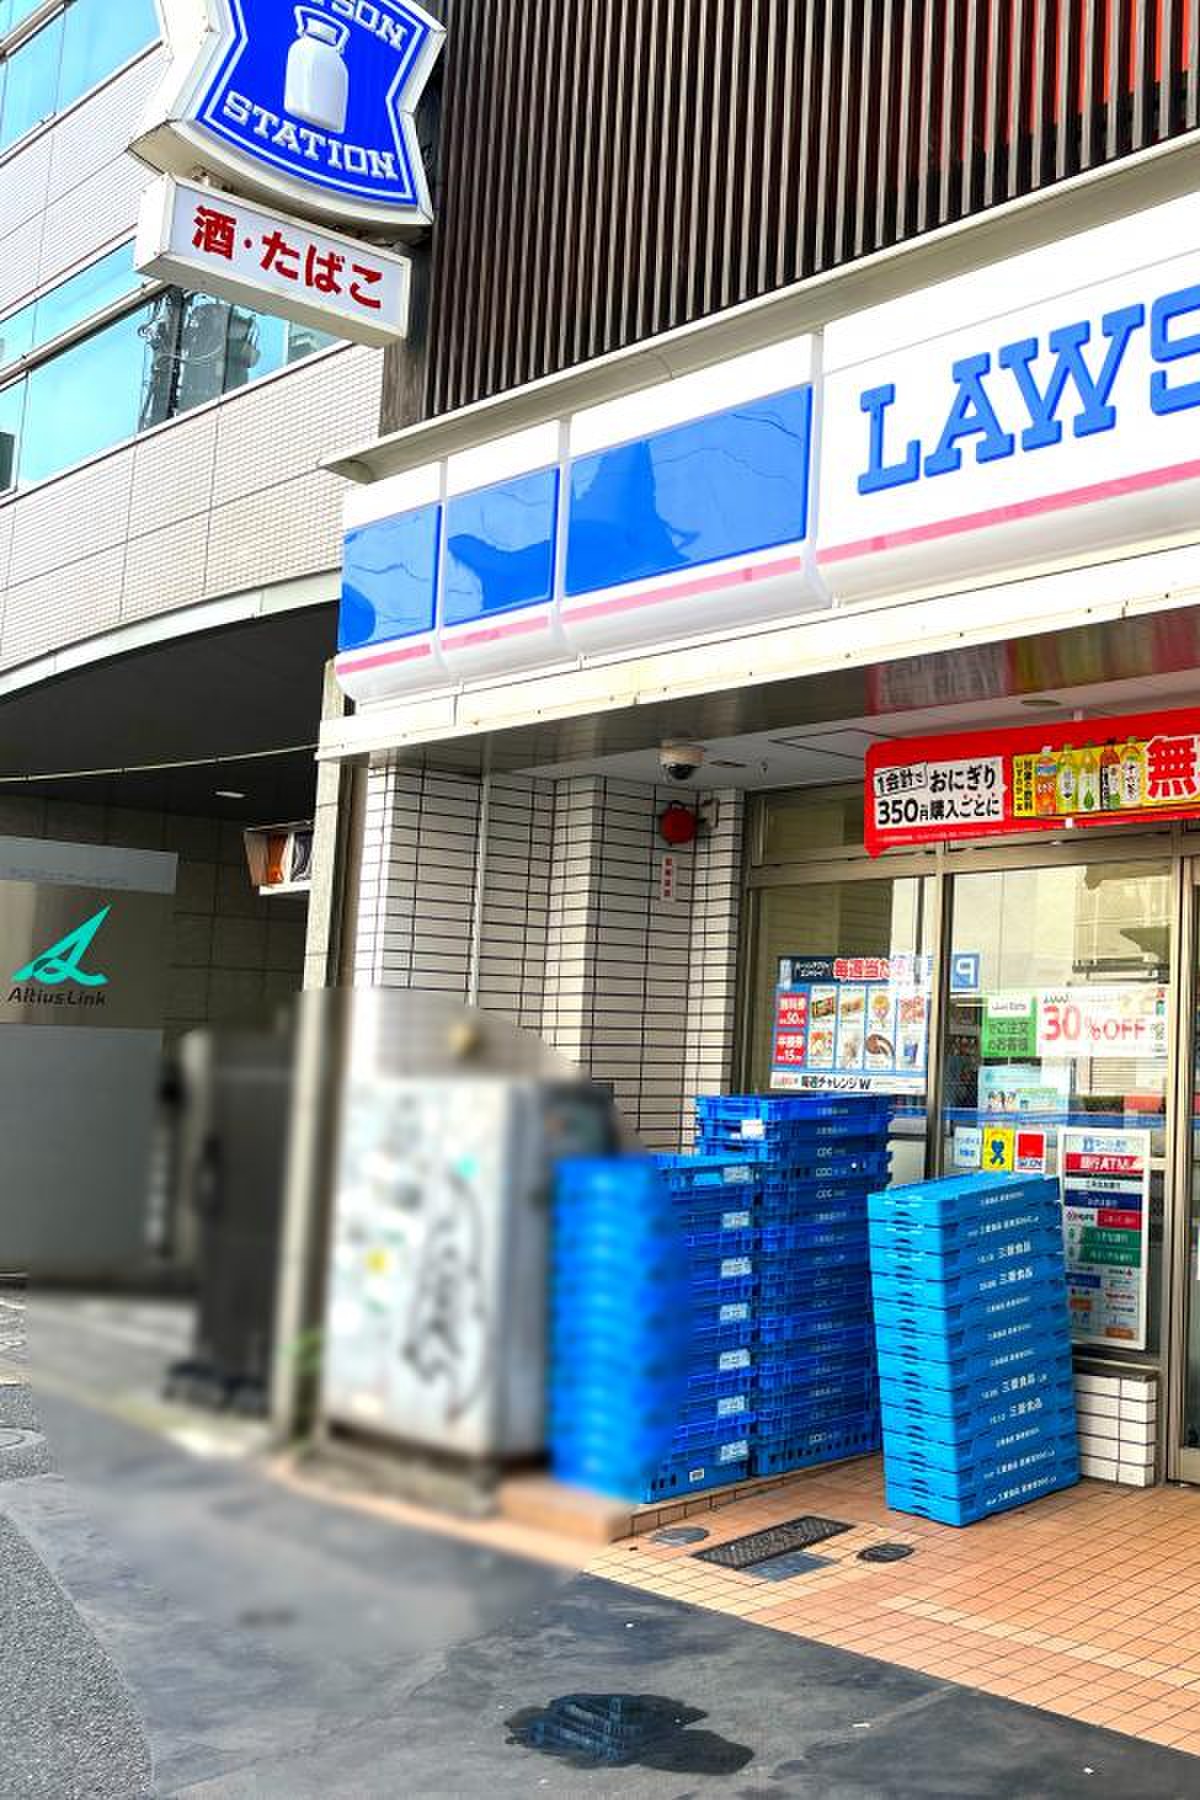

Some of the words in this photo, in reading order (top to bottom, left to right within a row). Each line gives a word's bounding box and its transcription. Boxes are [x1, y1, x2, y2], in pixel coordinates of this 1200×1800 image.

[314, 0, 408, 50] SON
[223, 90, 399, 179] STATION
[929, 764, 996, 793] おにぎり
[878, 793, 1000, 825] 350円購入ごとに
[7, 986, 106, 1006] AltiusLink
